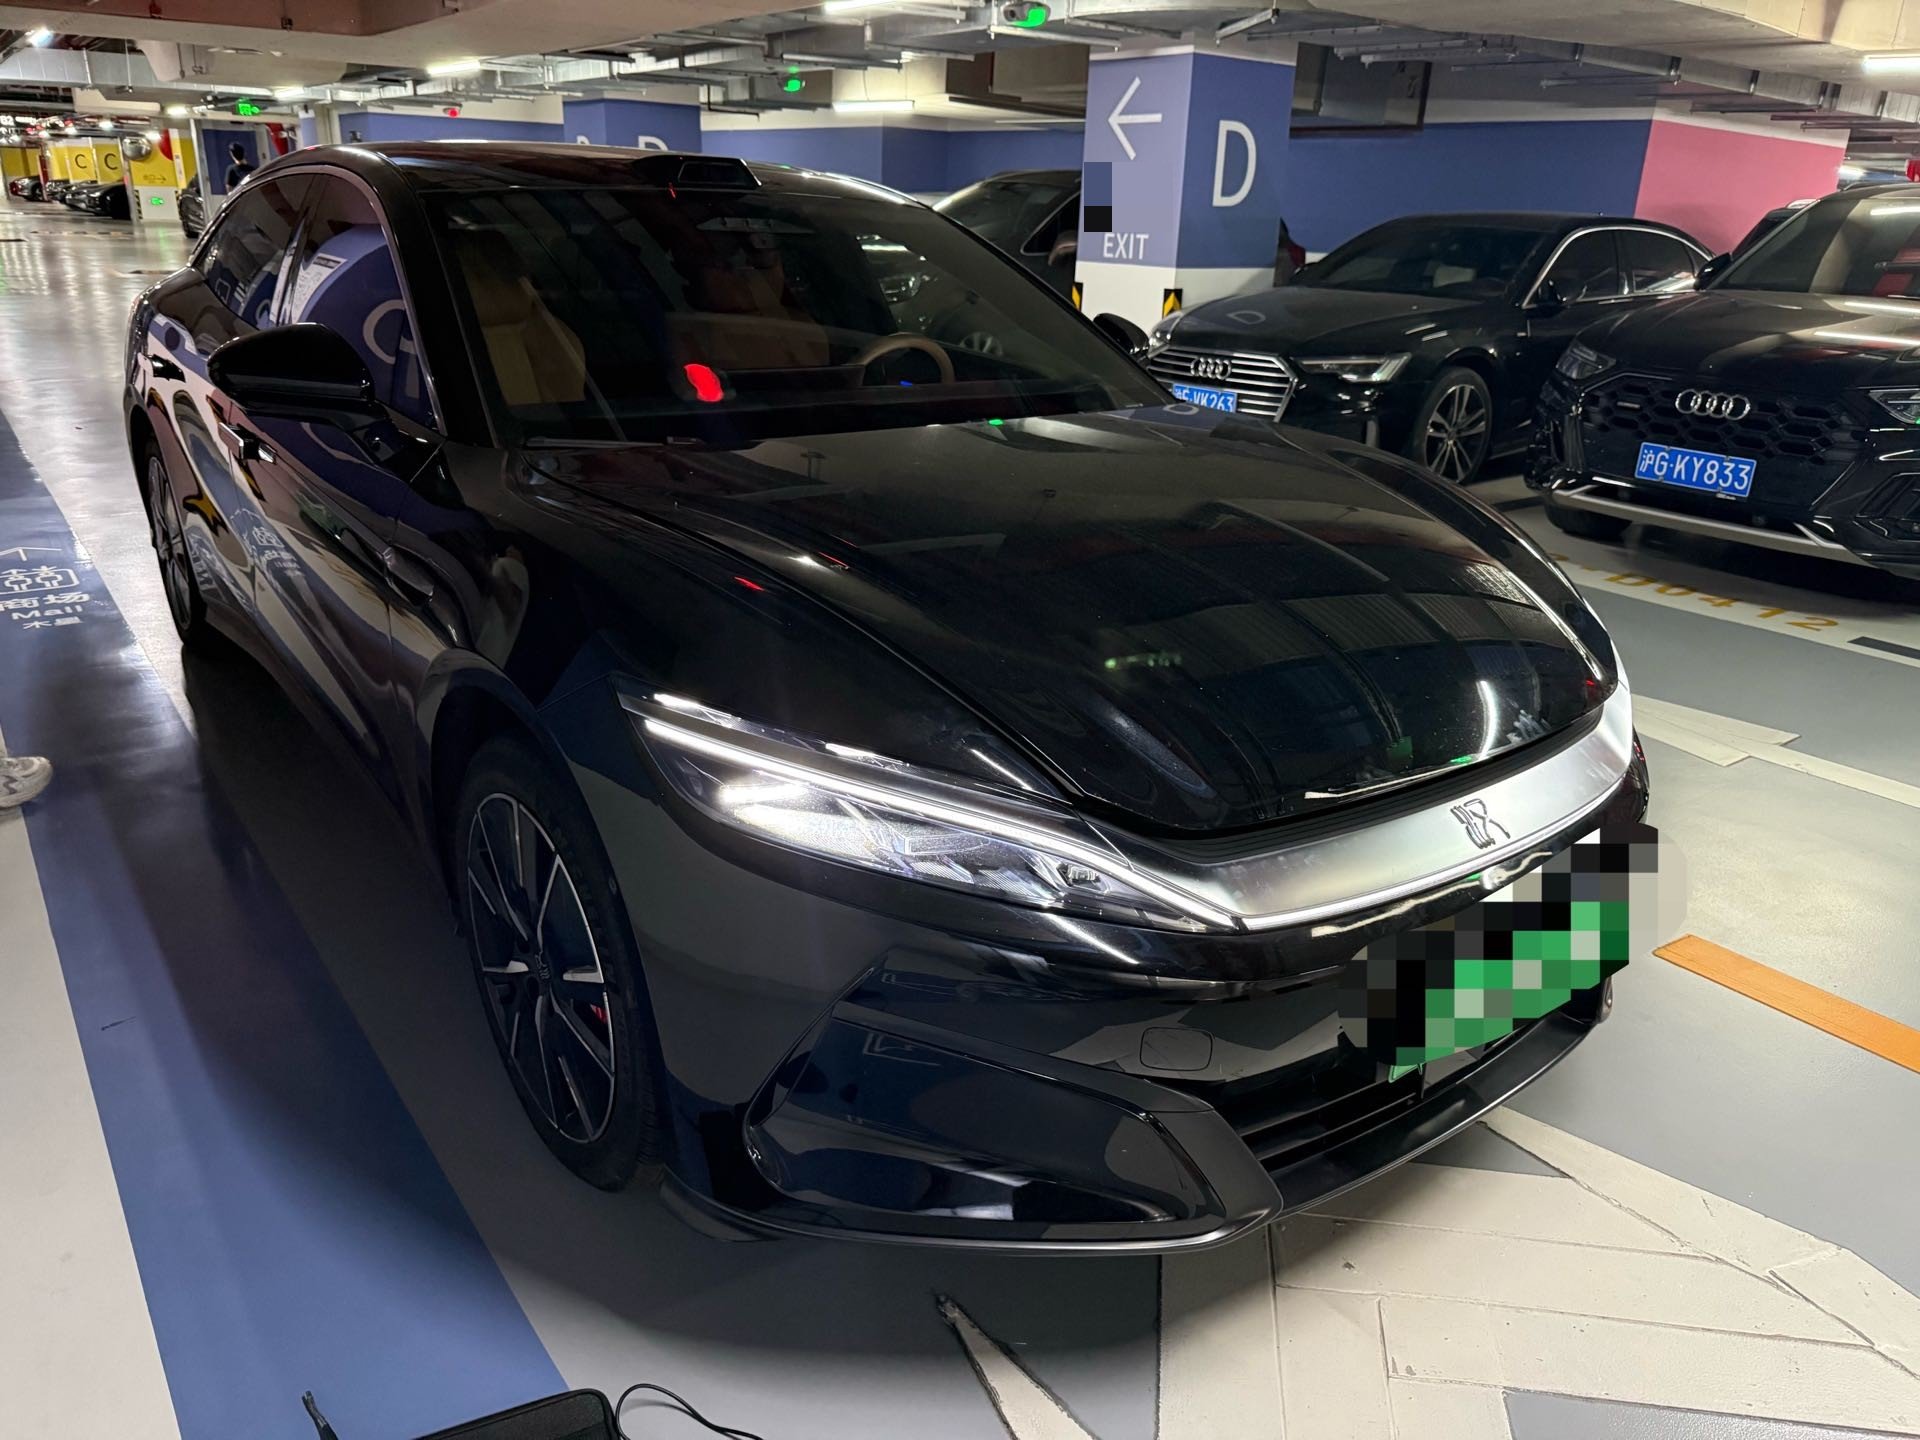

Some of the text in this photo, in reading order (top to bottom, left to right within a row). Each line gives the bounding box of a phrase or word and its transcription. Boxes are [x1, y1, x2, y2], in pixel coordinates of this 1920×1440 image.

[75, 154, 88, 169] C
[104, 153, 119, 170] C
[1212, 120, 1257, 207] D
[1102, 233, 1149, 260] EXIT
[12, 605, 83, 620] Mall
